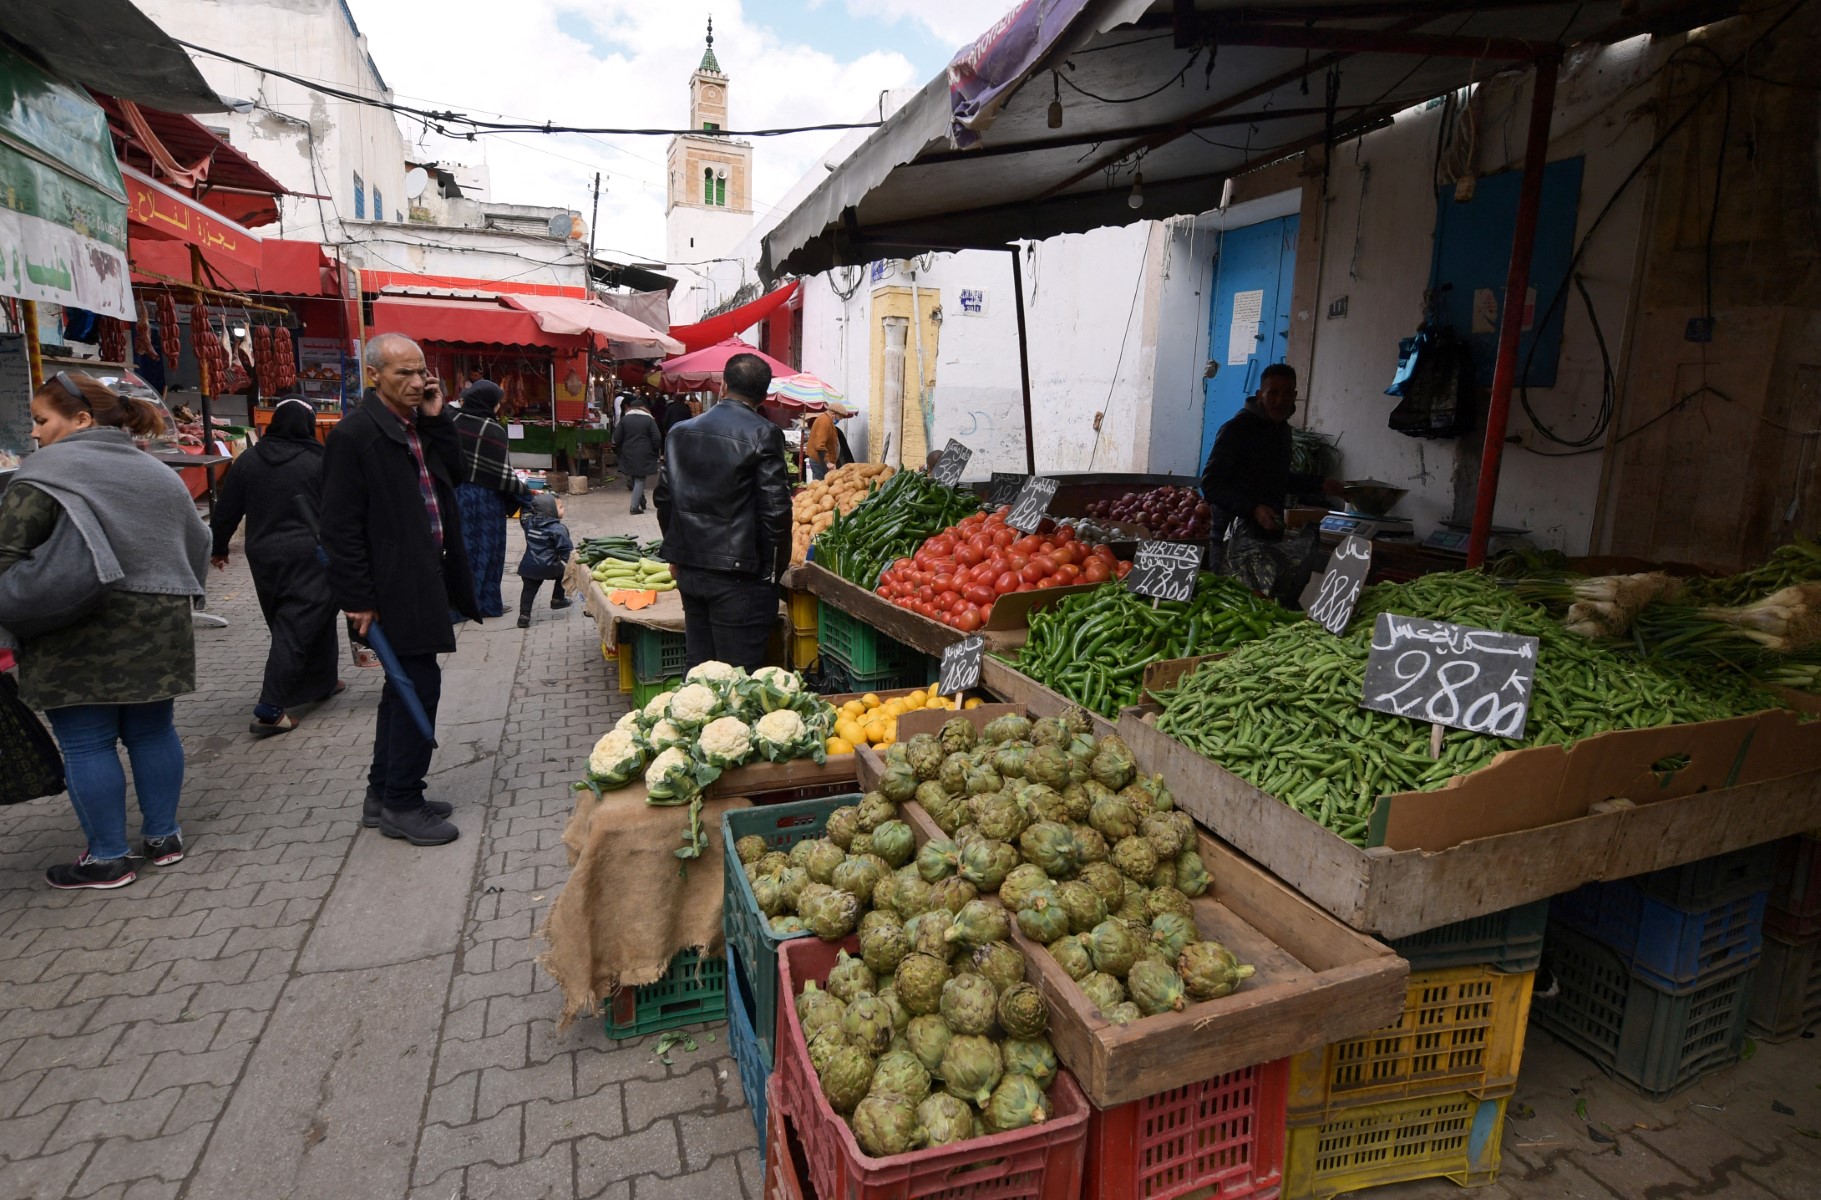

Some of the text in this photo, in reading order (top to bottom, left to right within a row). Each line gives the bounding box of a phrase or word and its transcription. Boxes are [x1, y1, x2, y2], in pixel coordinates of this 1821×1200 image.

[137, 189, 191, 231] الفلاح
[1141, 540, 1199, 561] SARTER
[1135, 567, 1190, 601] 4800
[939, 659, 979, 695] 1800
[1374, 650, 1526, 735] 2800
